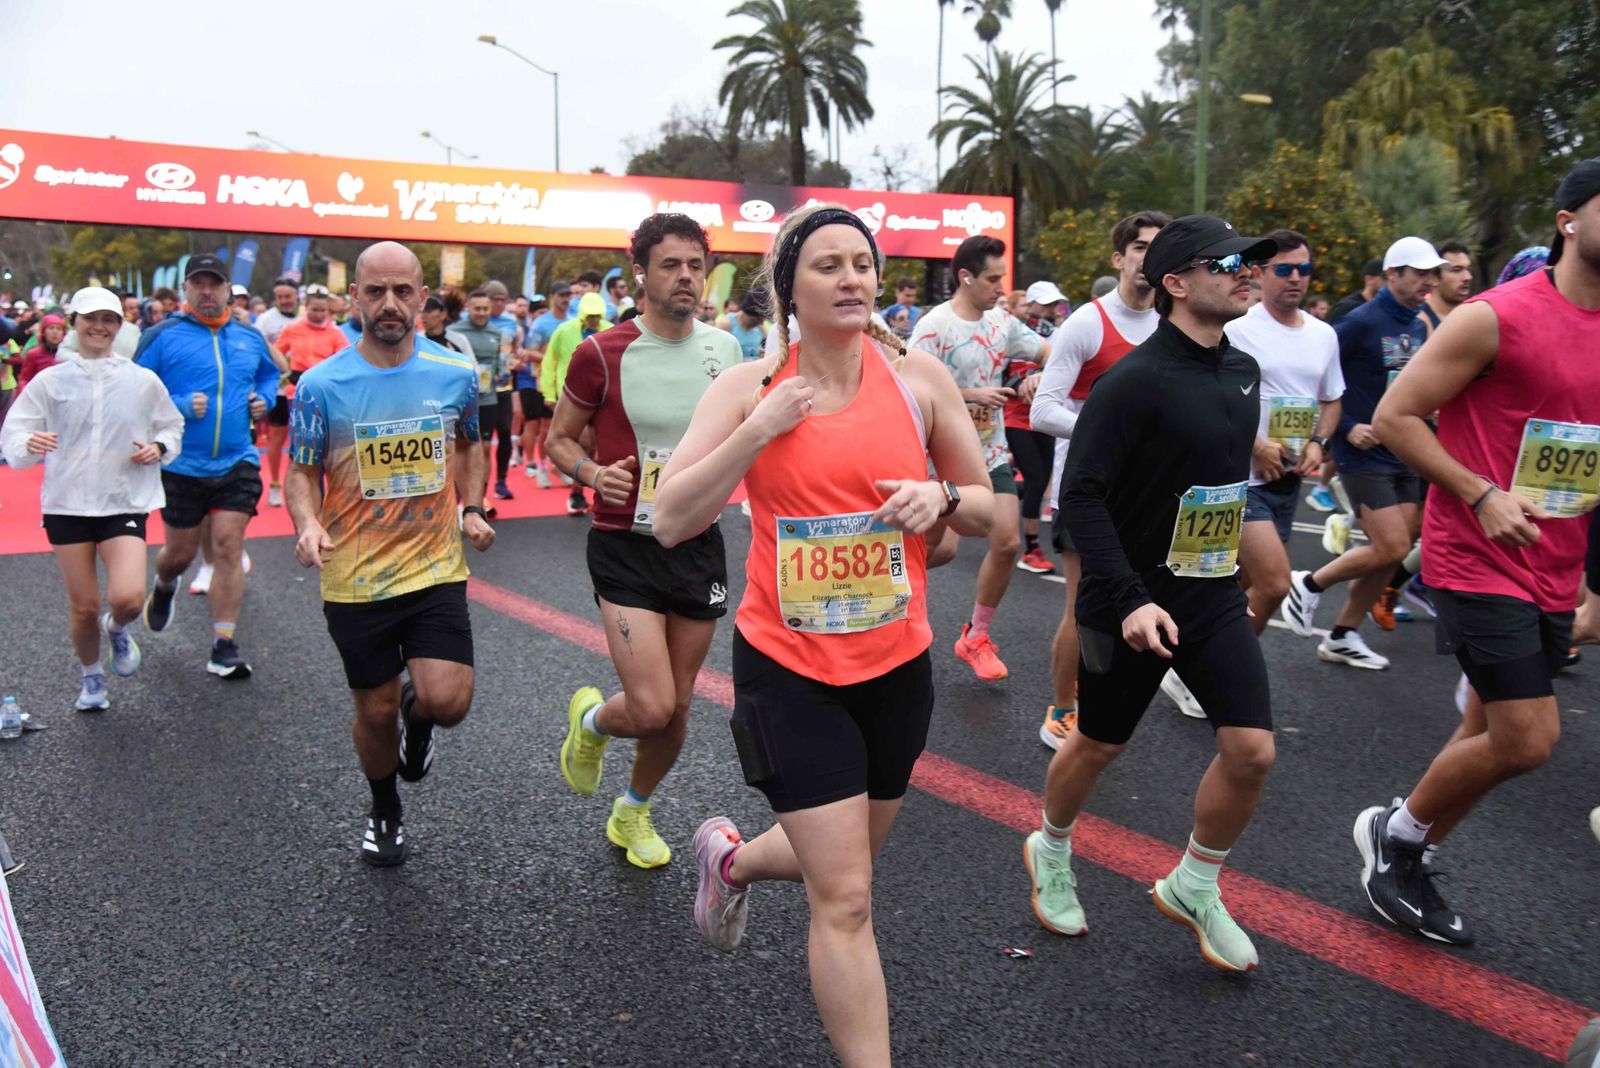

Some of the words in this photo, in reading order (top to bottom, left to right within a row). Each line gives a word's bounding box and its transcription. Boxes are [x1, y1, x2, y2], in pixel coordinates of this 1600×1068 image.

[34, 165, 129, 188] Sprinter
[216, 175, 311, 208] HOKA
[365, 437, 433, 465] 15420
[1536, 445, 1598, 477] 8979
[819, 516, 866, 528] maratón
[1186, 506, 1241, 537] 12791
[790, 542, 889, 581] 18582
[843, 592, 873, 600] Charnock
